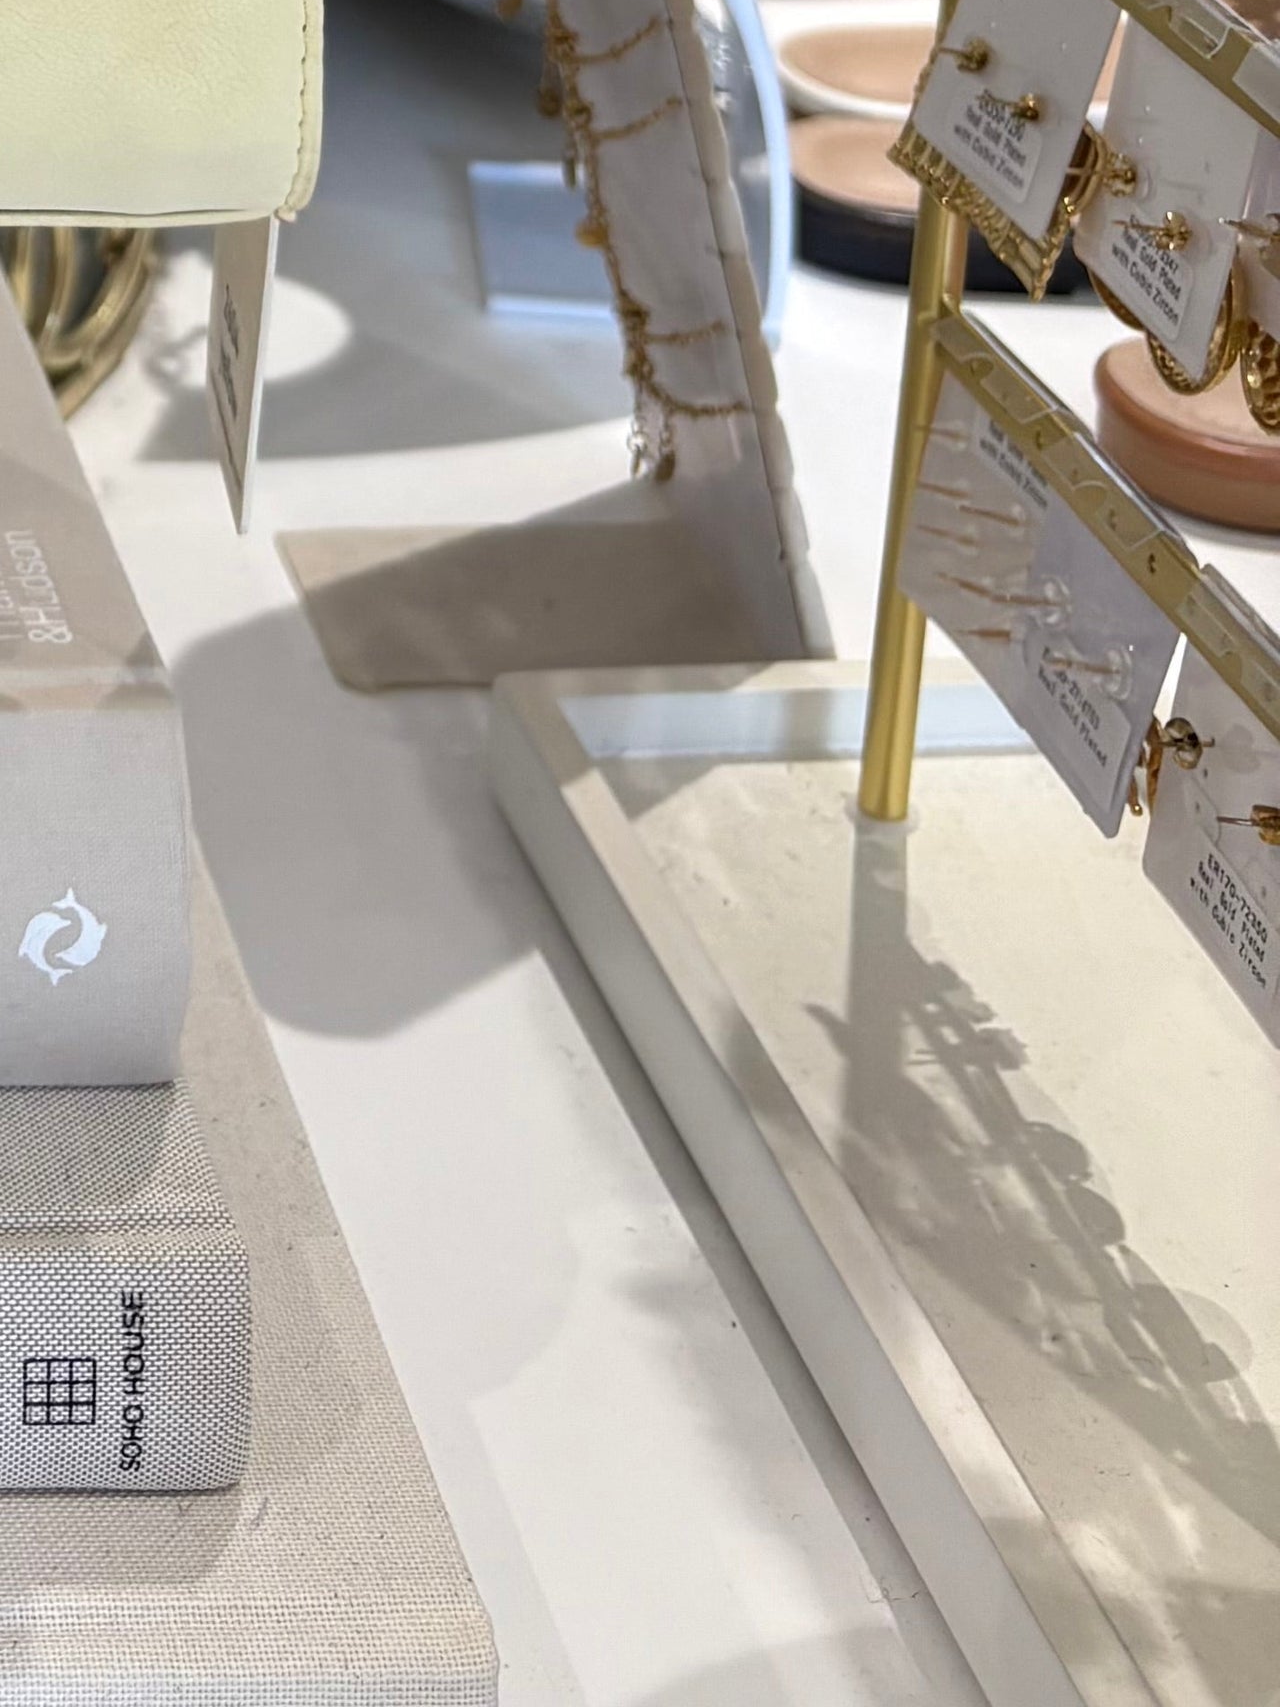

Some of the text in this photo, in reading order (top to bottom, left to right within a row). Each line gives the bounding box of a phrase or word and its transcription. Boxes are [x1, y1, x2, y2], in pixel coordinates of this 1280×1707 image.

[5, 530, 70, 629] Hudson
[119, 1291, 145, 1472] SOHO HOUSE
